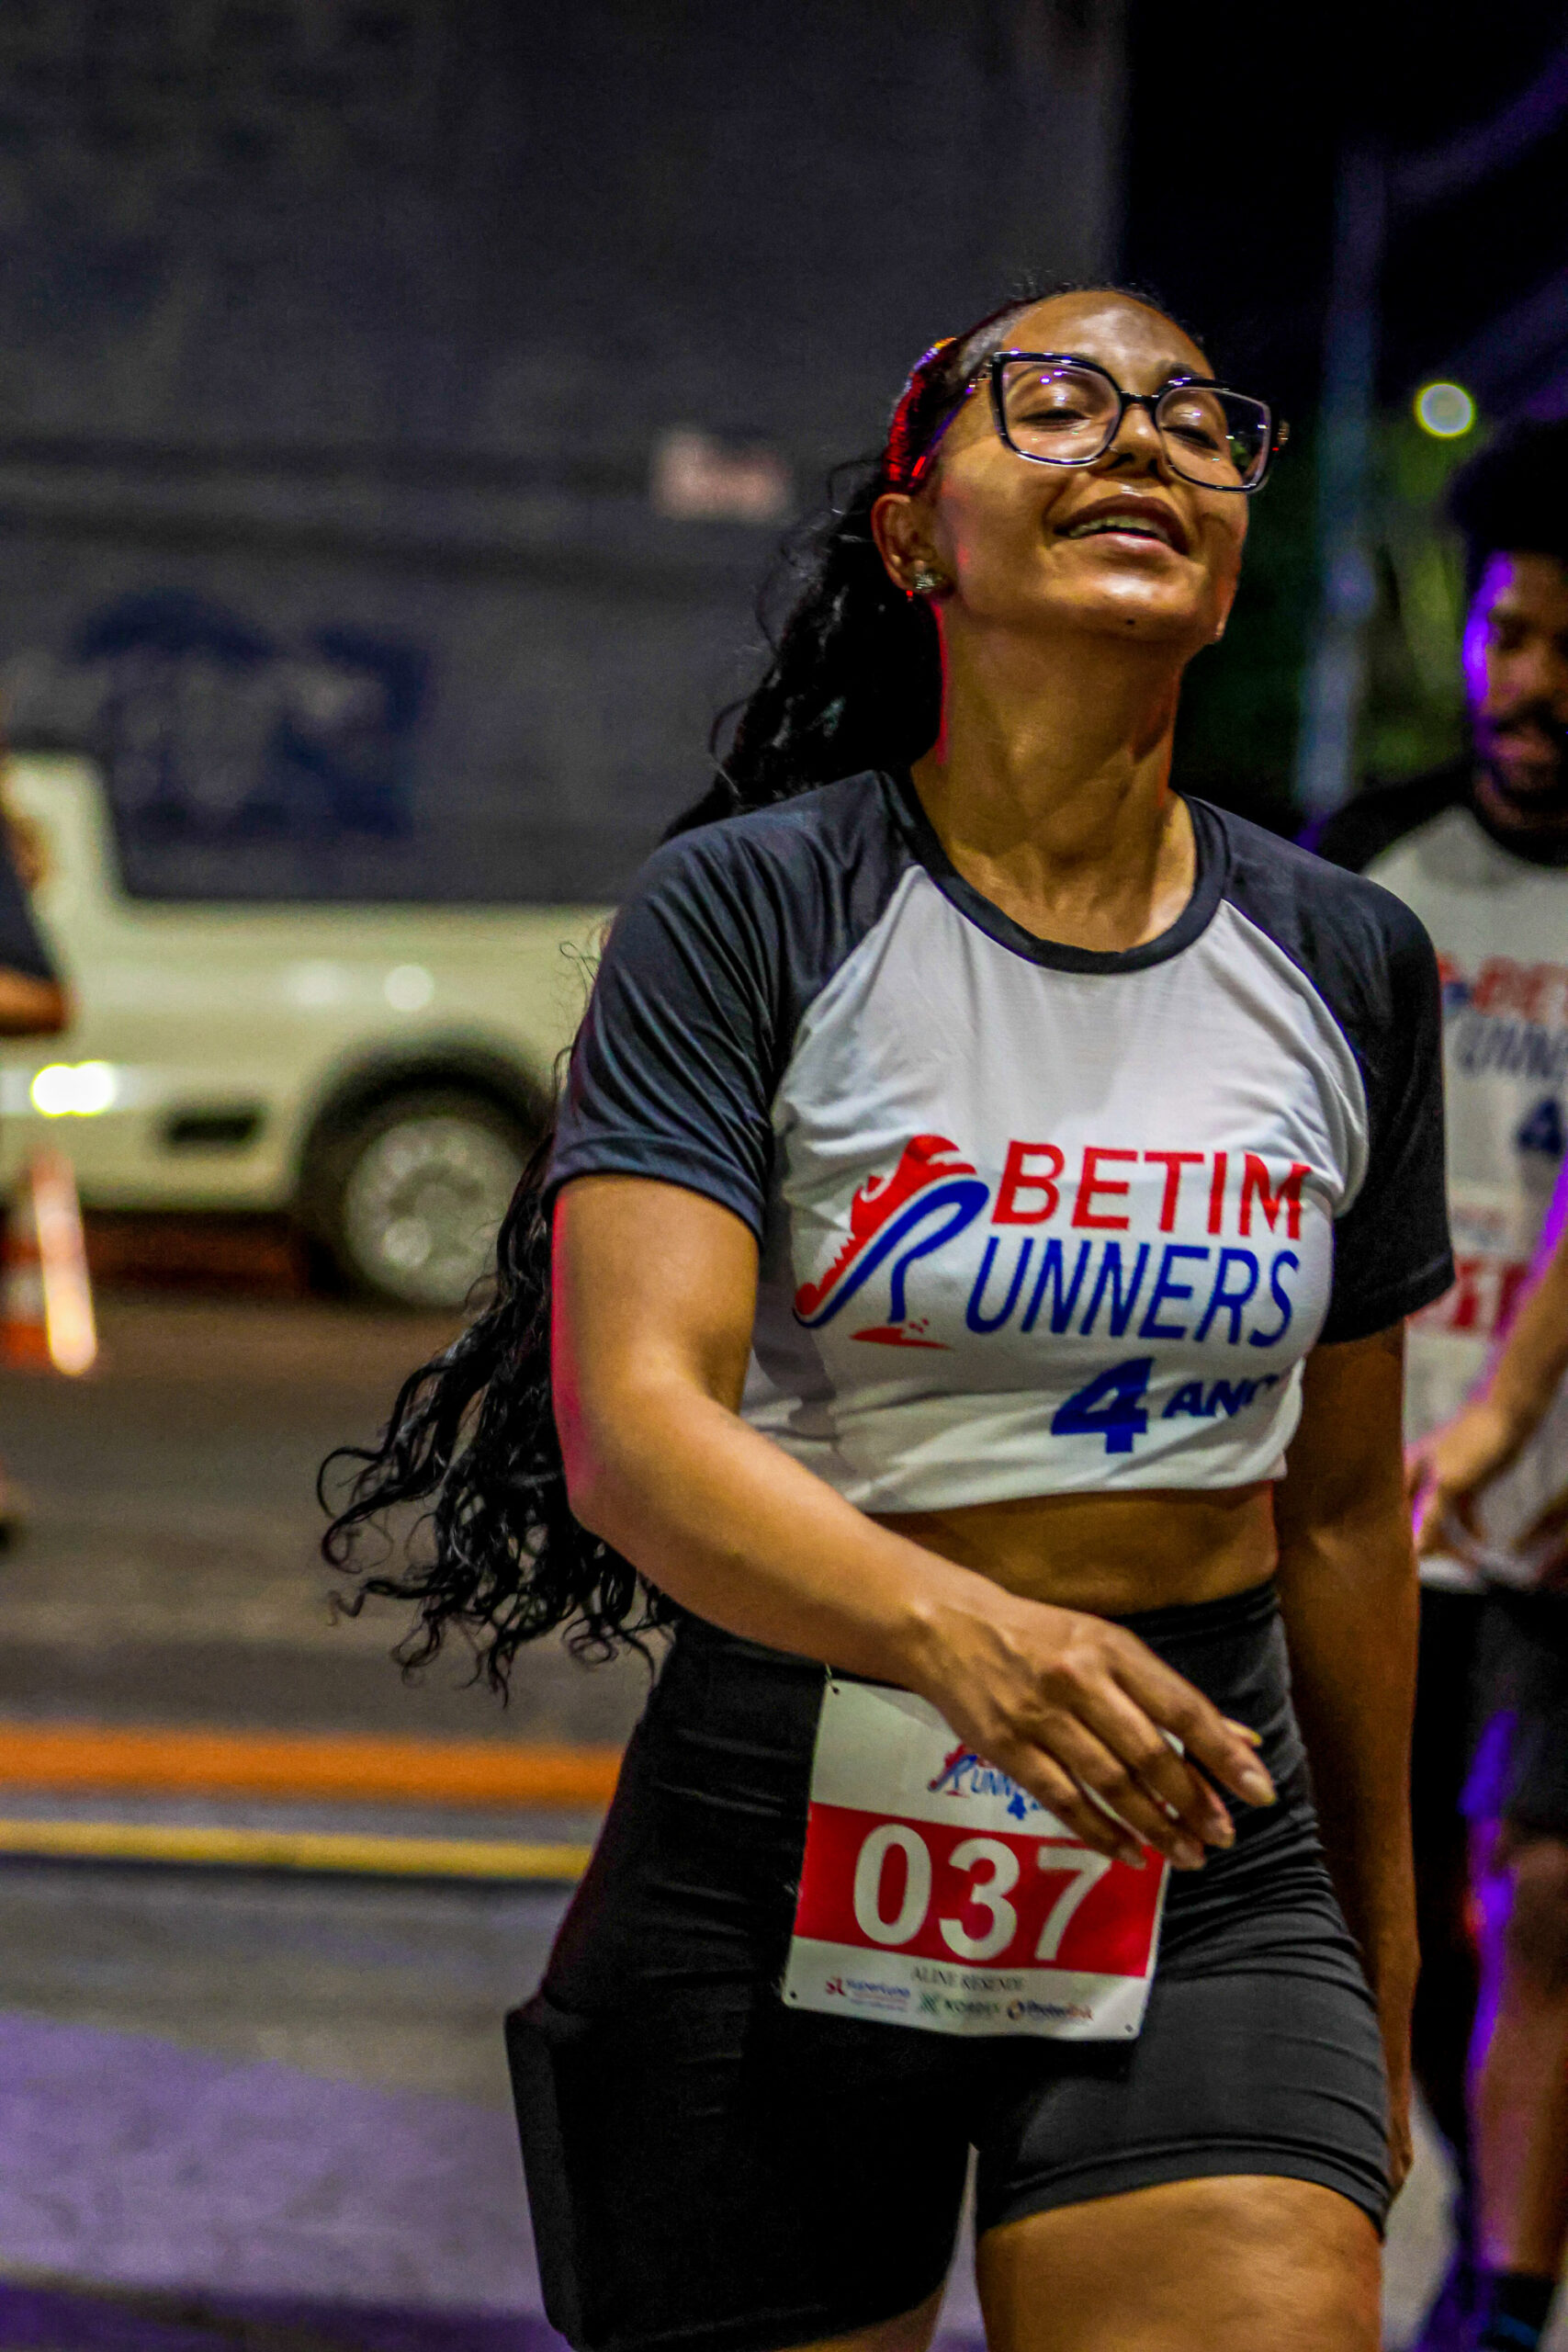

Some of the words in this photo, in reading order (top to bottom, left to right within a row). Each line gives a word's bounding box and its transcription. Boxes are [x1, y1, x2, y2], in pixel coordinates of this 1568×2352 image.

[991, 1140, 1311, 1240] BETIM
[1051, 1357, 1155, 1453] 4
[1162, 1374, 1280, 1418] AN
[853, 1824, 1111, 1962] 037
